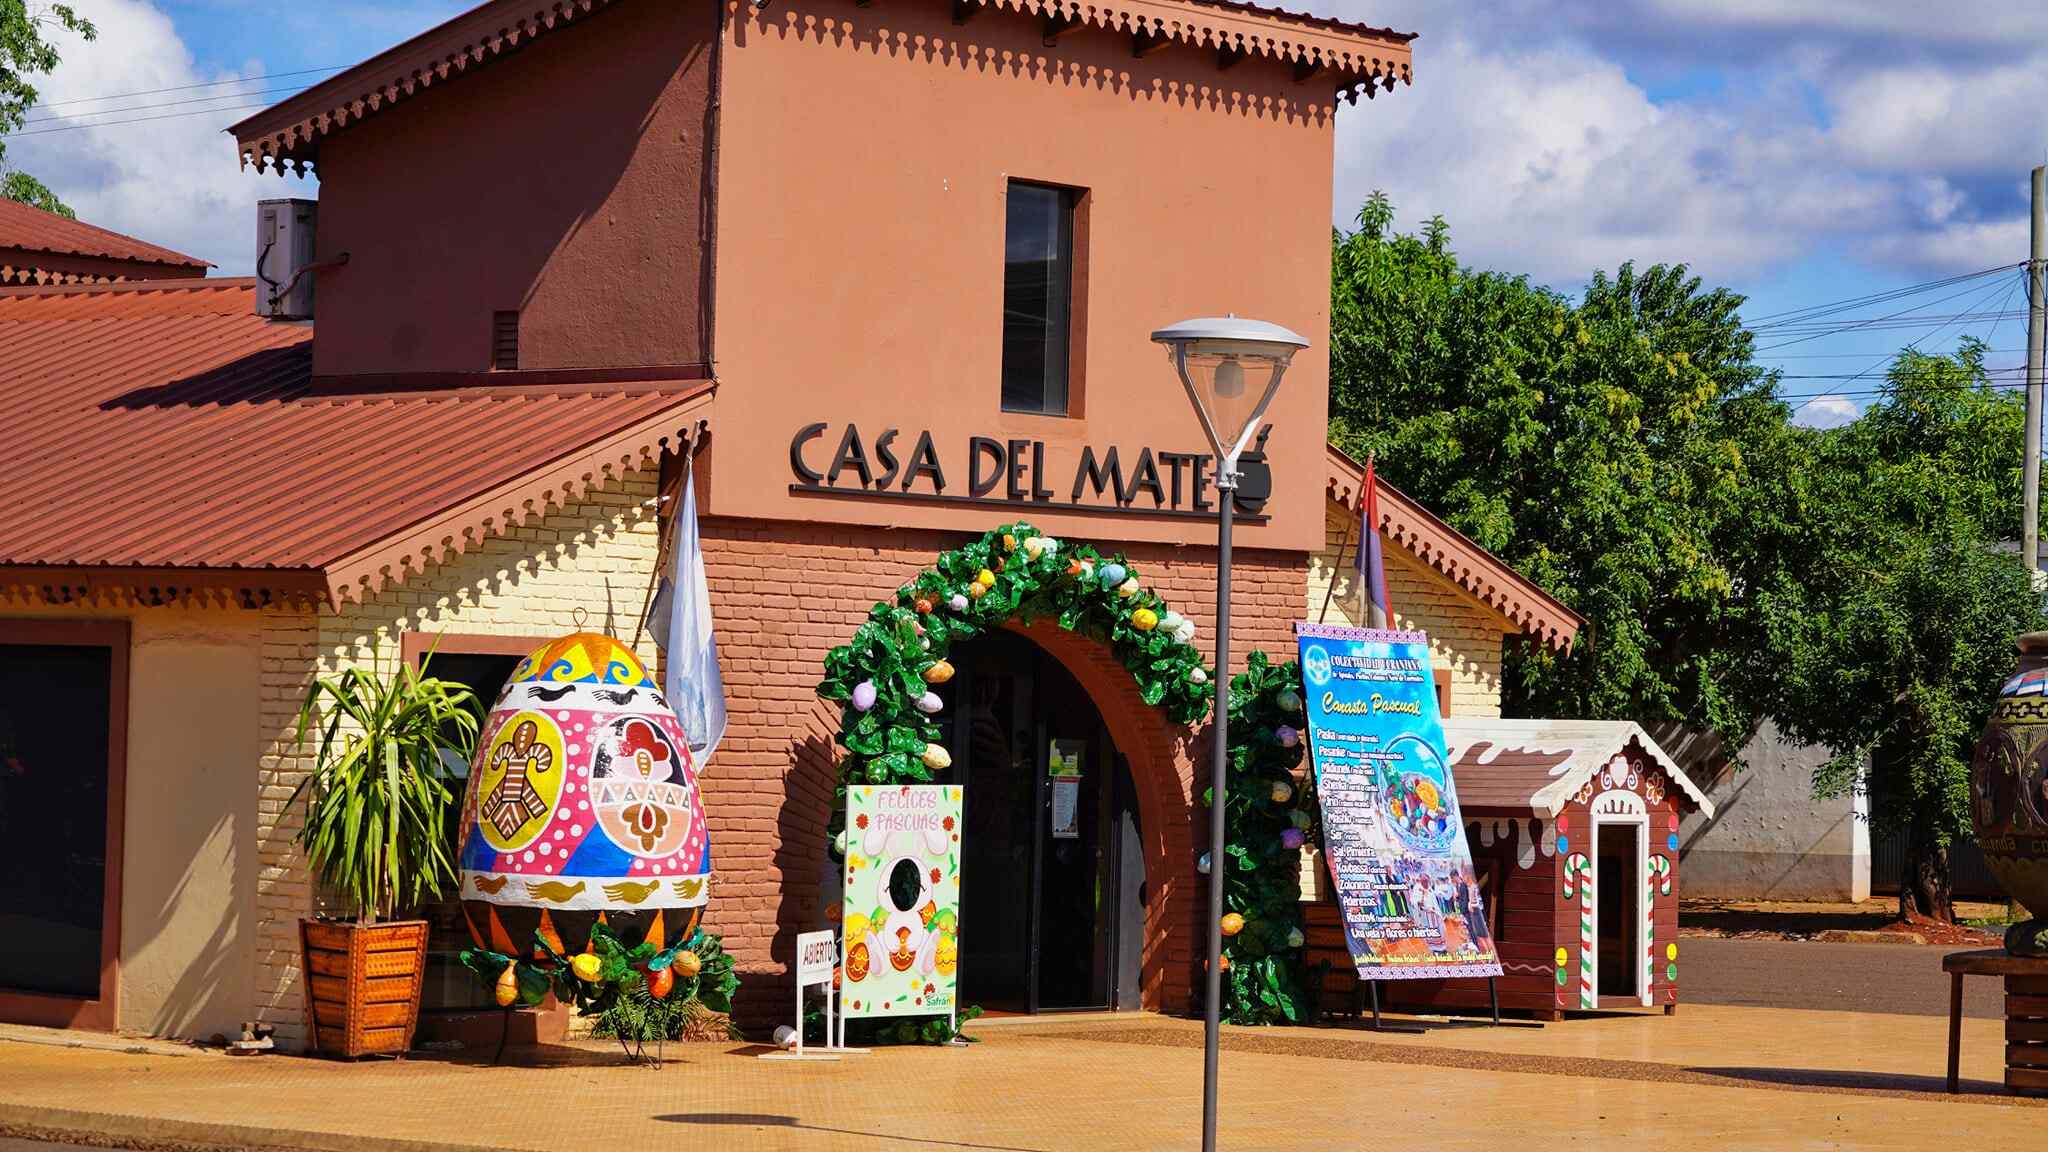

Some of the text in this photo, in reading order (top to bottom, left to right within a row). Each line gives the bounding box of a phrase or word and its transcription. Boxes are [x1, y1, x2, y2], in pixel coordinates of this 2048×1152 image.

[789, 422, 1214, 511] CASA DEL MATE
[1322, 691, 1422, 716] Canasta Pascual
[878, 790, 937, 809] FELICES
[875, 813, 939, 832] PASCUAS
[803, 940, 832, 965] ABIERTO
